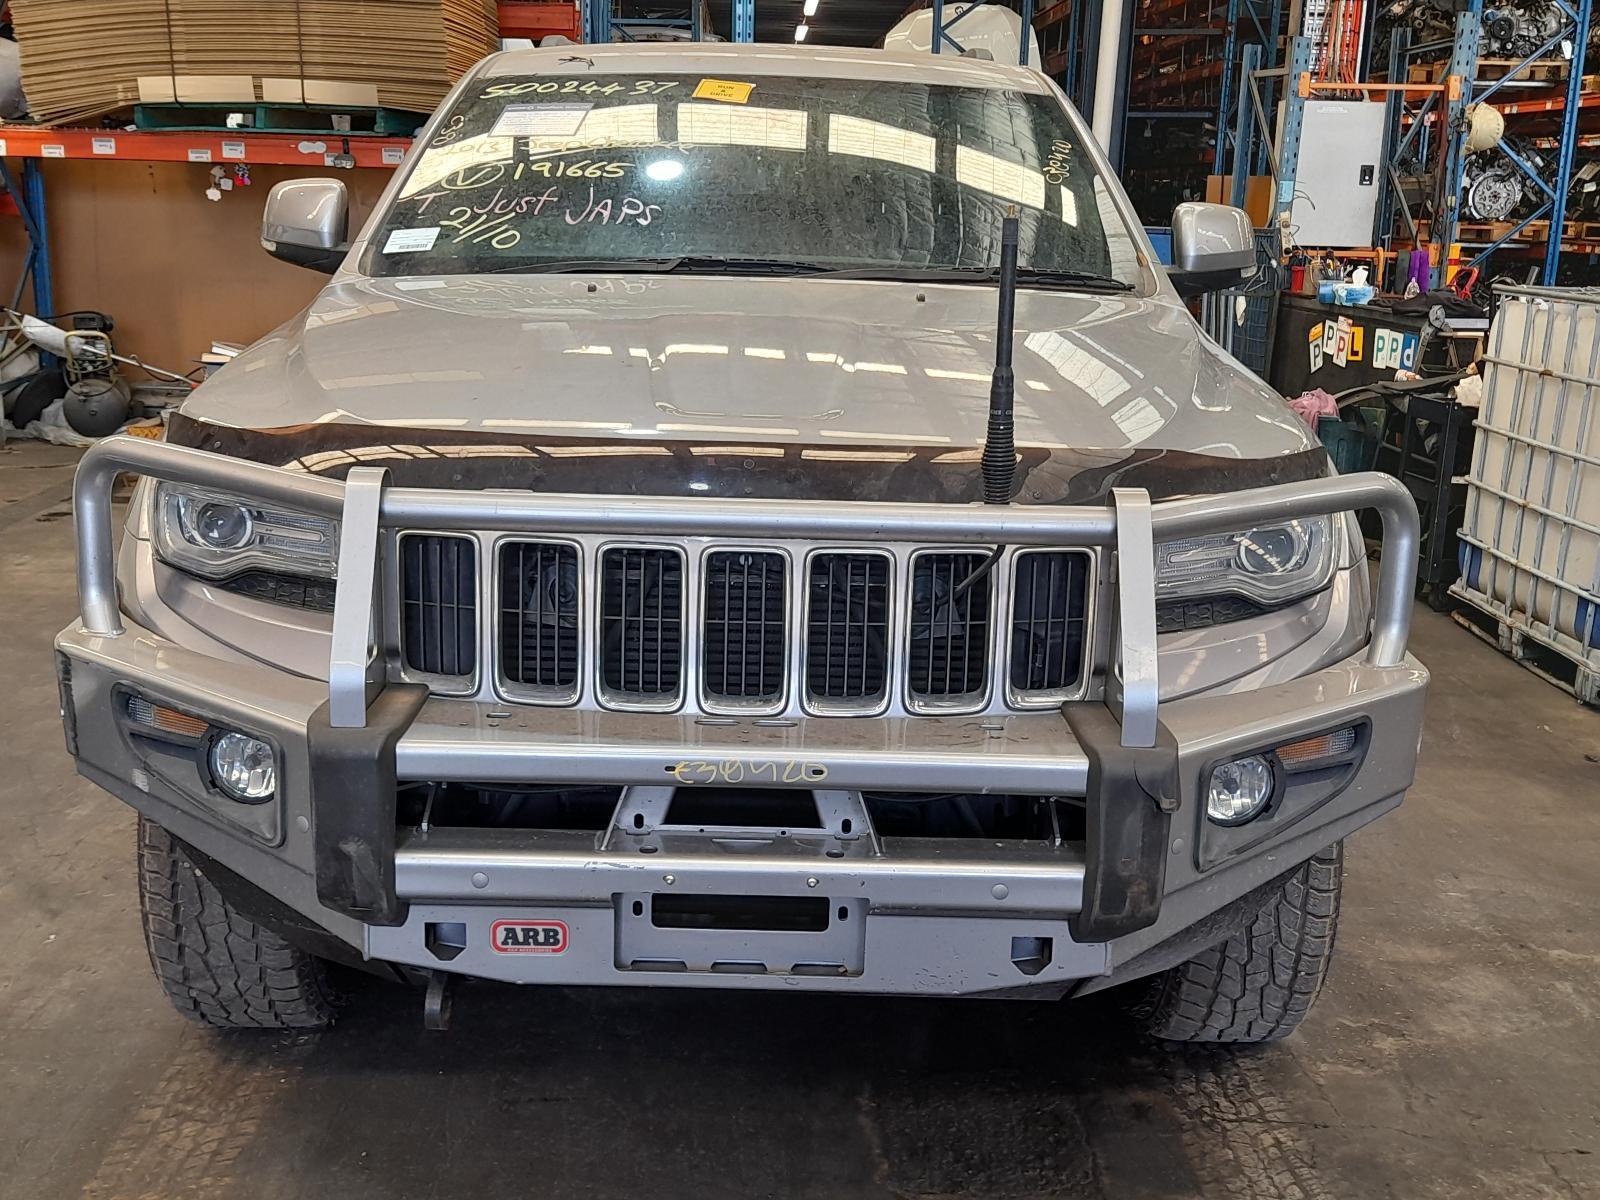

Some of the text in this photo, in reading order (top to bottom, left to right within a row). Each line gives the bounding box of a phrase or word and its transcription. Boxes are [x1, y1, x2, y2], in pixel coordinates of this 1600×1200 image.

[513, 160, 635, 181] 191665
[1313, 343, 1321, 367] P
[1336, 336, 1346, 360] P
[1350, 332, 1359, 357] L
[1375, 335, 1385, 362] P
[1389, 337, 1398, 361] P
[501, 927, 560, 946] ARB
